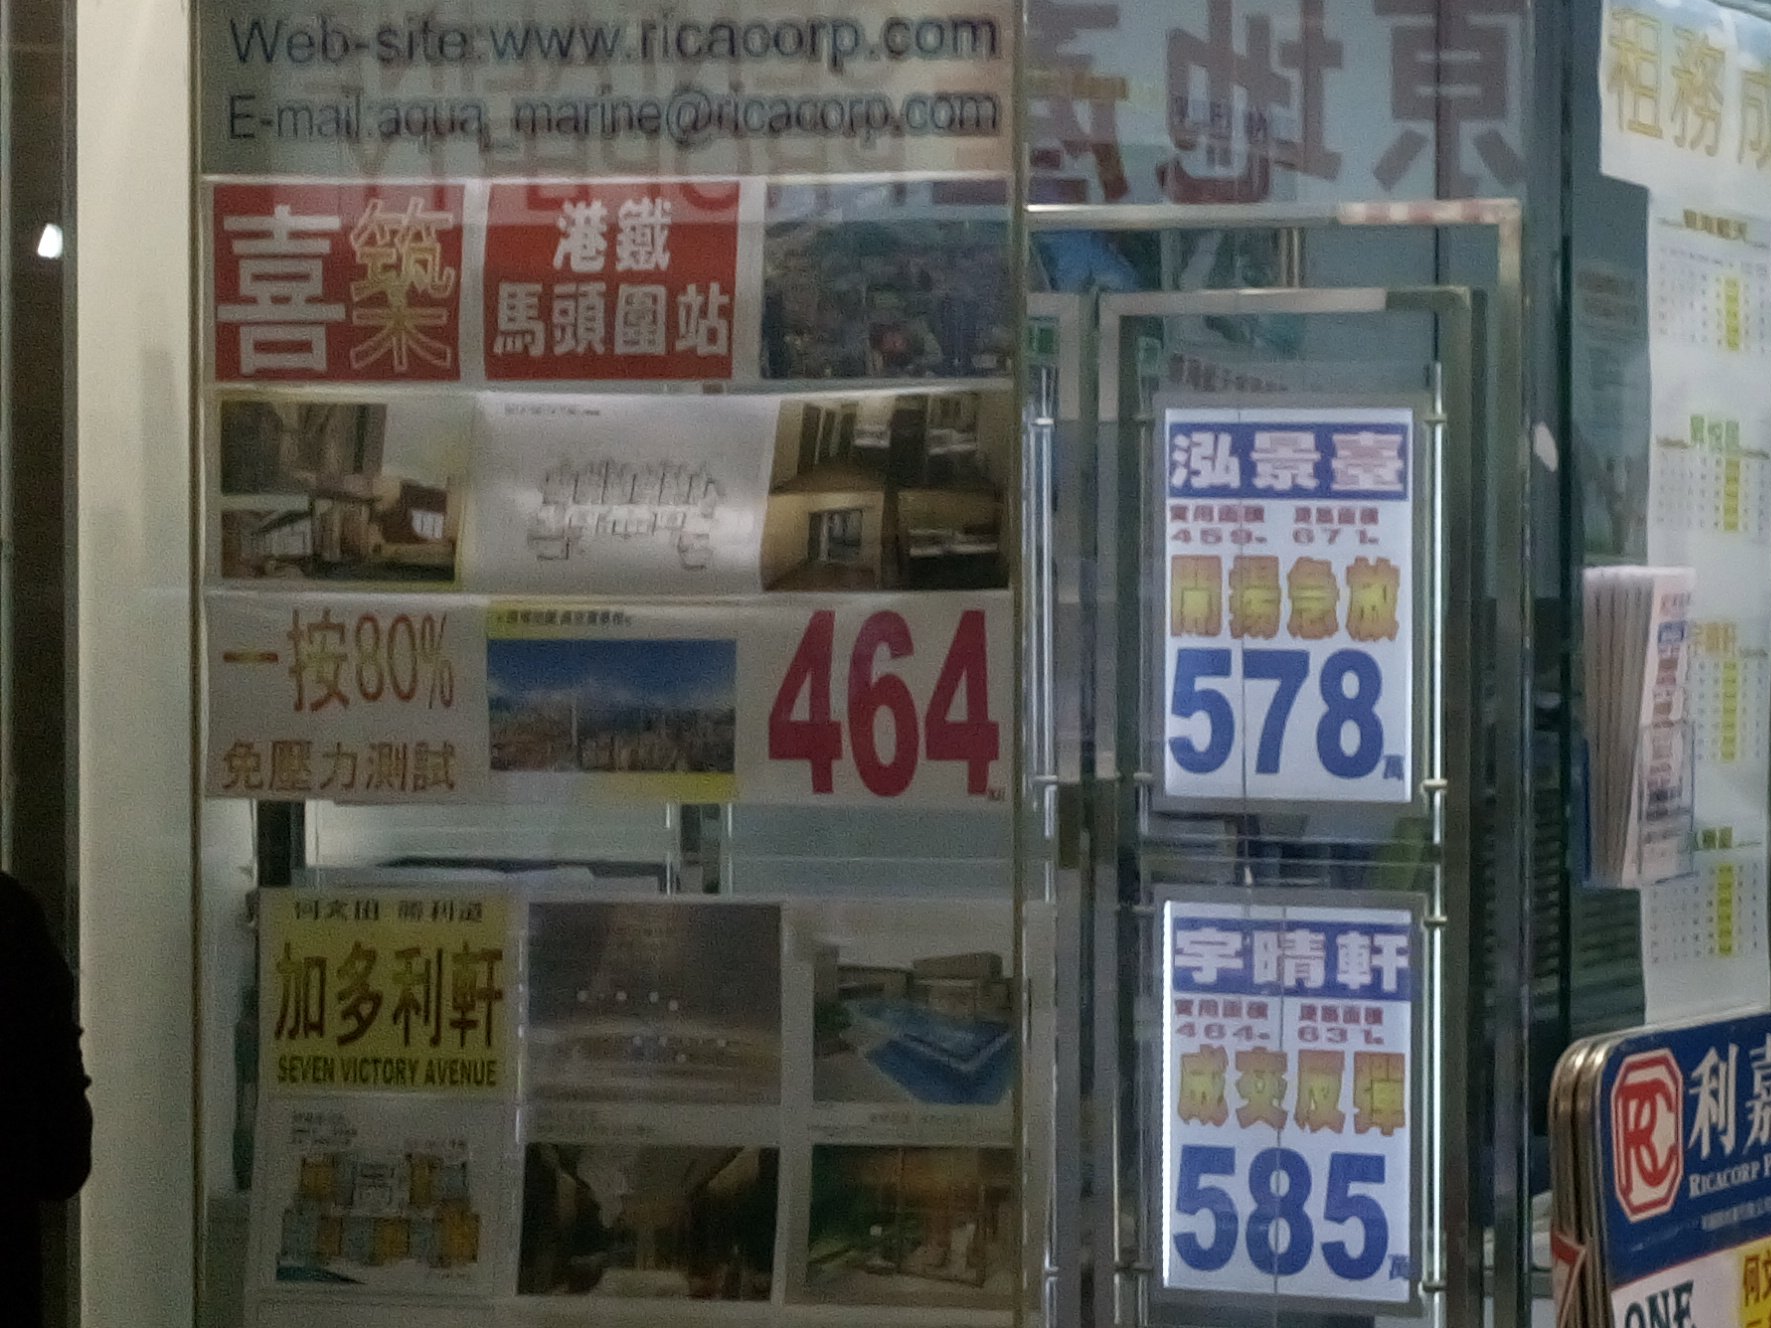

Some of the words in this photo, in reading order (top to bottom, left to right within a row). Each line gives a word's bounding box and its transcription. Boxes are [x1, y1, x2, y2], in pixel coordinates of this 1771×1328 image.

[552, 197, 671, 273] 港鐵
[492, 281, 730, 360] 馬頭圍站
[1170, 430, 1404, 492] 泓景臺
[222, 609, 455, 713] 一按80%
[766, 609, 1001, 798] 464
[221, 740, 456, 794] 免壓力測試
[274, 941, 504, 1050] 加多利軒
[1174, 926, 1408, 993] 宇晴軒
[277, 1055, 335, 1085] SEVEN
[340, 1056, 419, 1086] VICTORY
[423, 1057, 497, 1088] AVENUE
